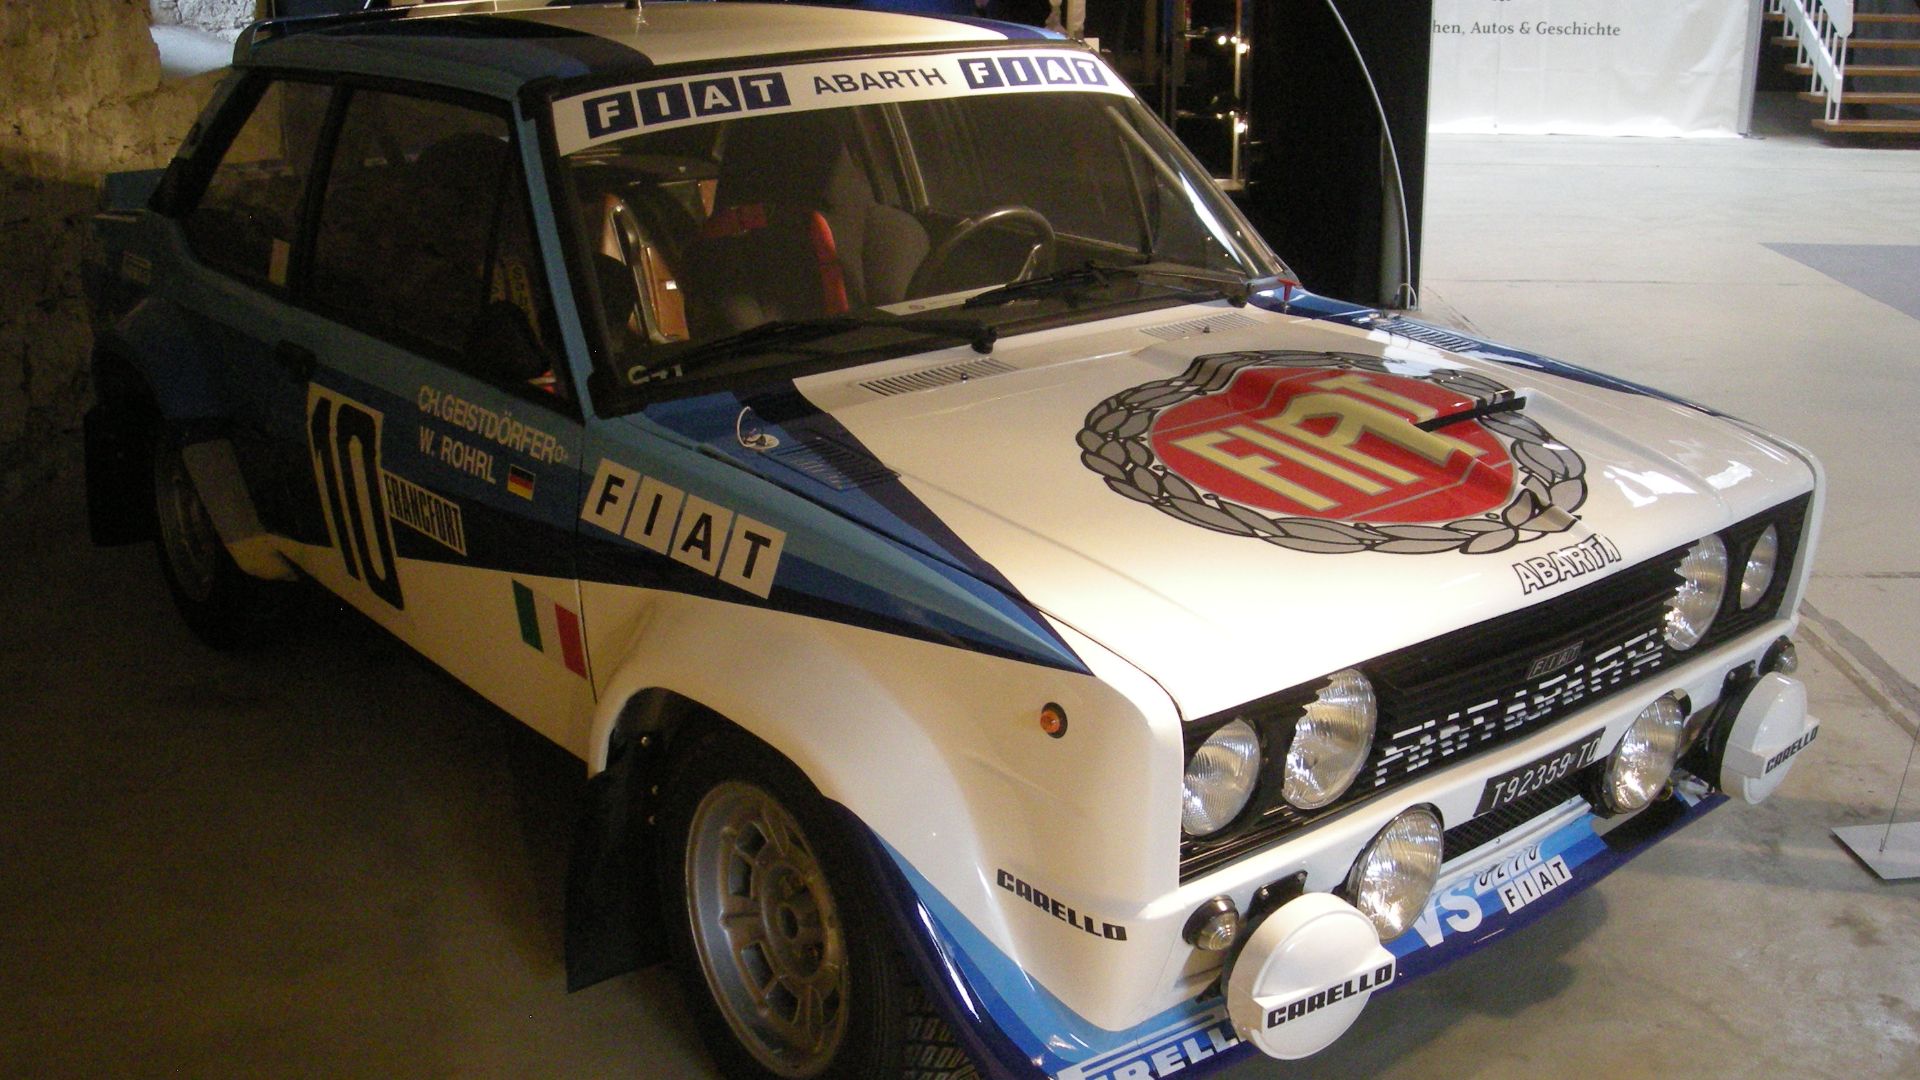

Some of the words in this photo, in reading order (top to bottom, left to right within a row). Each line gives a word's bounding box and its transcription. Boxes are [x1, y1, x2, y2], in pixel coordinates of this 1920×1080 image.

[1471, 21, 1514, 34] Autos
[1519, 21, 1530, 34] &
[1536, 21, 1621, 36] Geschichte
[596, 77, 777, 129] FIAT
[813, 67, 947, 95] ABARTH
[965, 57, 1103, 87] FIAT
[418, 425, 435, 457] W.
[440, 435, 496, 485] ROHRL
[1171, 375, 1486, 513] FIAT
[312, 396, 404, 611] 10
[596, 474, 772, 579] FIAT
[1491, 752, 1571, 809] T92359
[1765, 725, 1820, 775] CARELLO
[996, 868, 1127, 941] CARELLO
[1505, 861, 1566, 908] FIAT
[1268, 962, 1393, 1030] CARELLO
